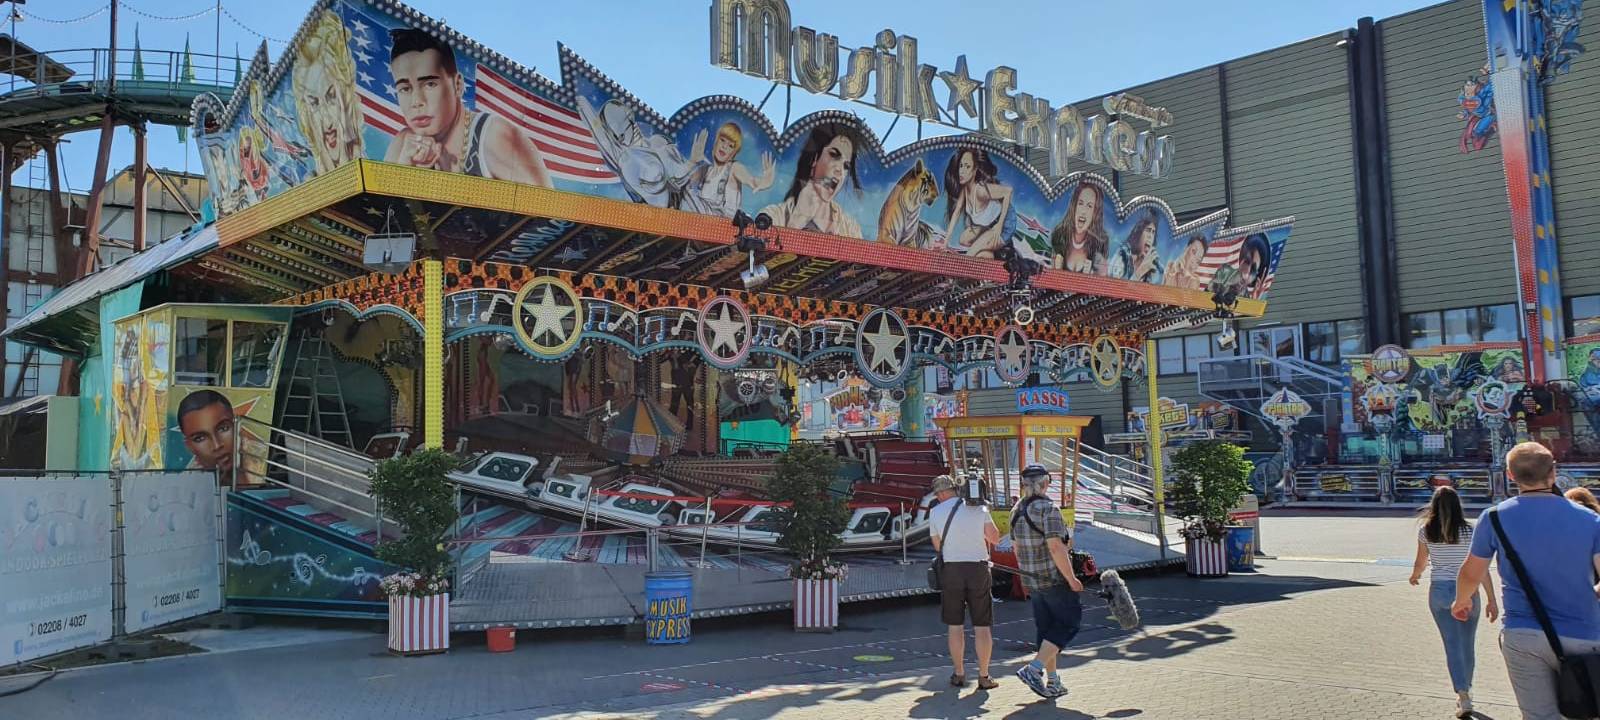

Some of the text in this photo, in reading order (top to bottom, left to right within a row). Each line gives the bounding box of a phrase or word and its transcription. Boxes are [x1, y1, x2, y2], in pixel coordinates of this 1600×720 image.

[710, 0, 1175, 178] Musik Express
[1019, 391, 1067, 409] KASSE
[649, 596, 688, 617] MUSIK
[37, 619, 62, 635] 02208
[69, 614, 87, 628] 4027
[647, 616, 691, 639] XPRES
